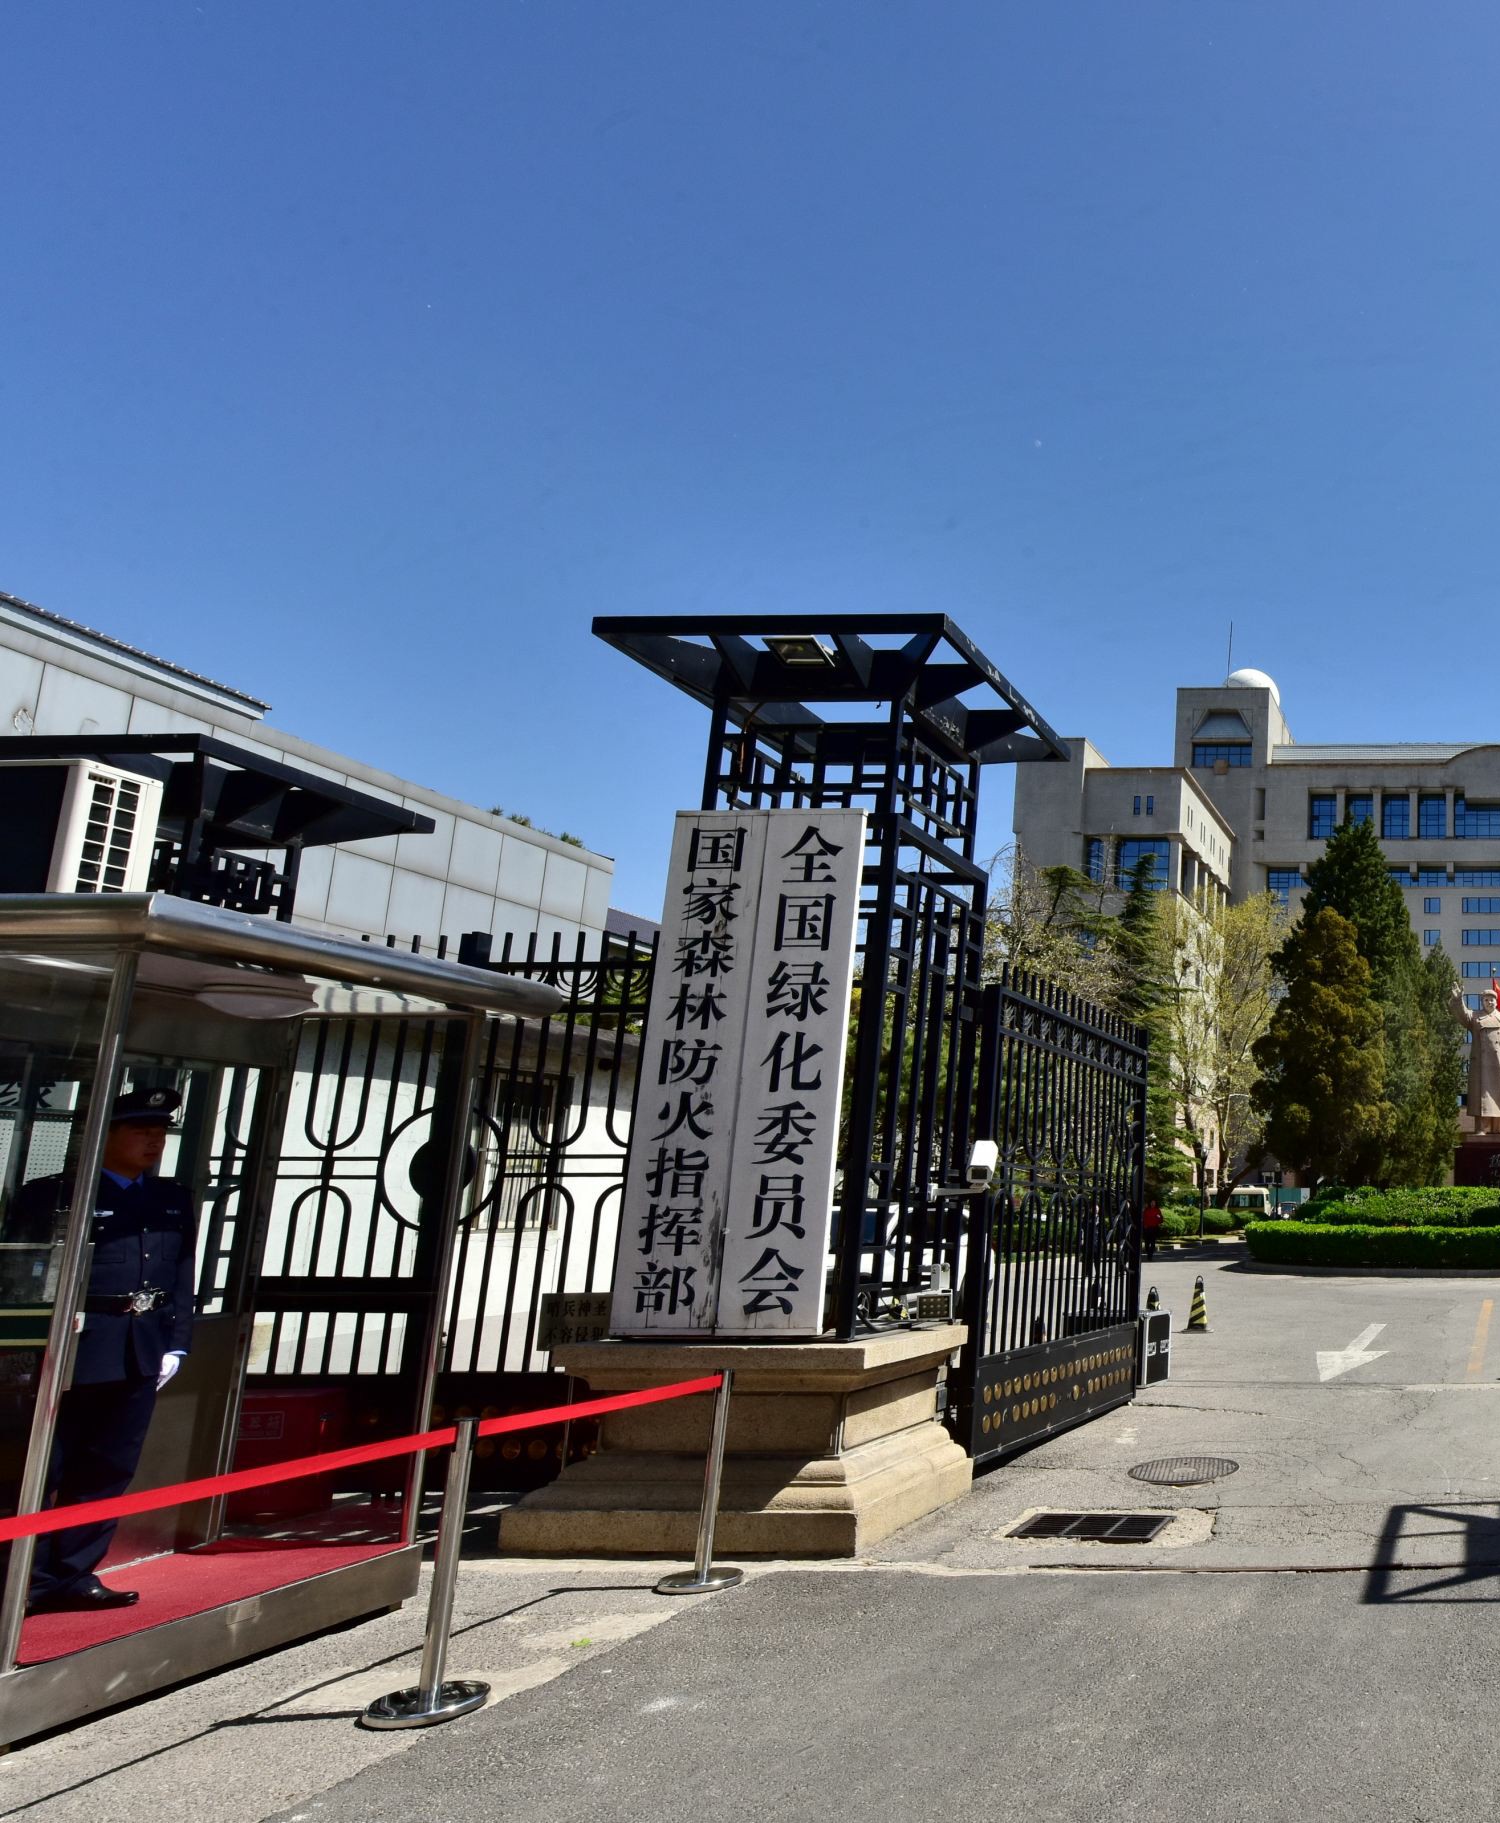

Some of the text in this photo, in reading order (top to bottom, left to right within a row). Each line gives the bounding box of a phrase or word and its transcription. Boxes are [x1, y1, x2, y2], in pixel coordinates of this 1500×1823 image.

[633, 826, 748, 1316] 国家森林防火指挥部
[737, 824, 842, 1317] 全国绿化委员会
